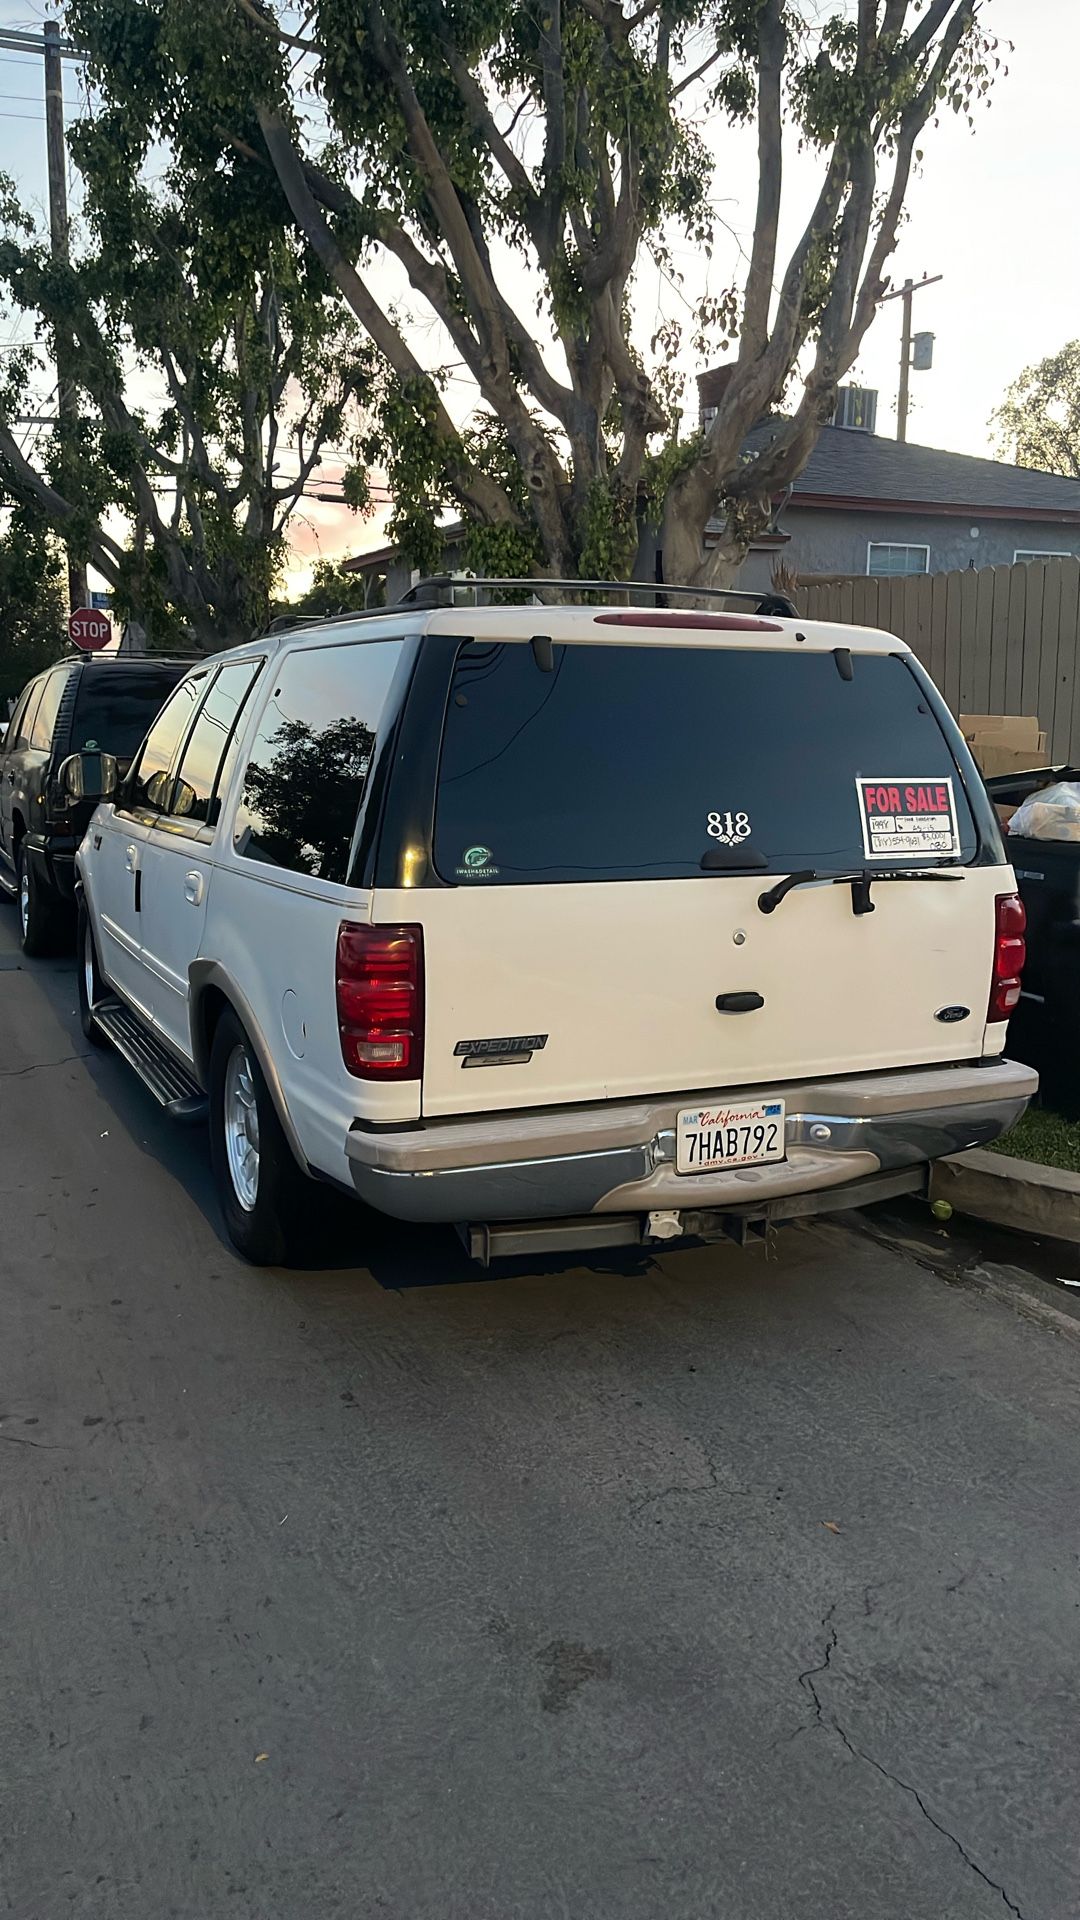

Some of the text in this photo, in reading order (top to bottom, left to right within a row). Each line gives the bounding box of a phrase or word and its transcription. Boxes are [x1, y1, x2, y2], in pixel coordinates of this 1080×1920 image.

[71, 621, 108, 638] STOP
[865, 787, 949, 813] FOR SALE
[707, 811, 752, 837] 818
[455, 1036, 547, 1054] EXPEDITION
[682, 1115, 698, 1125] MAR
[701, 1109, 765, 1127] California
[685, 1123, 778, 1163] 7HAB792
[703, 1154, 759, 1167] dmv.ca.gov
